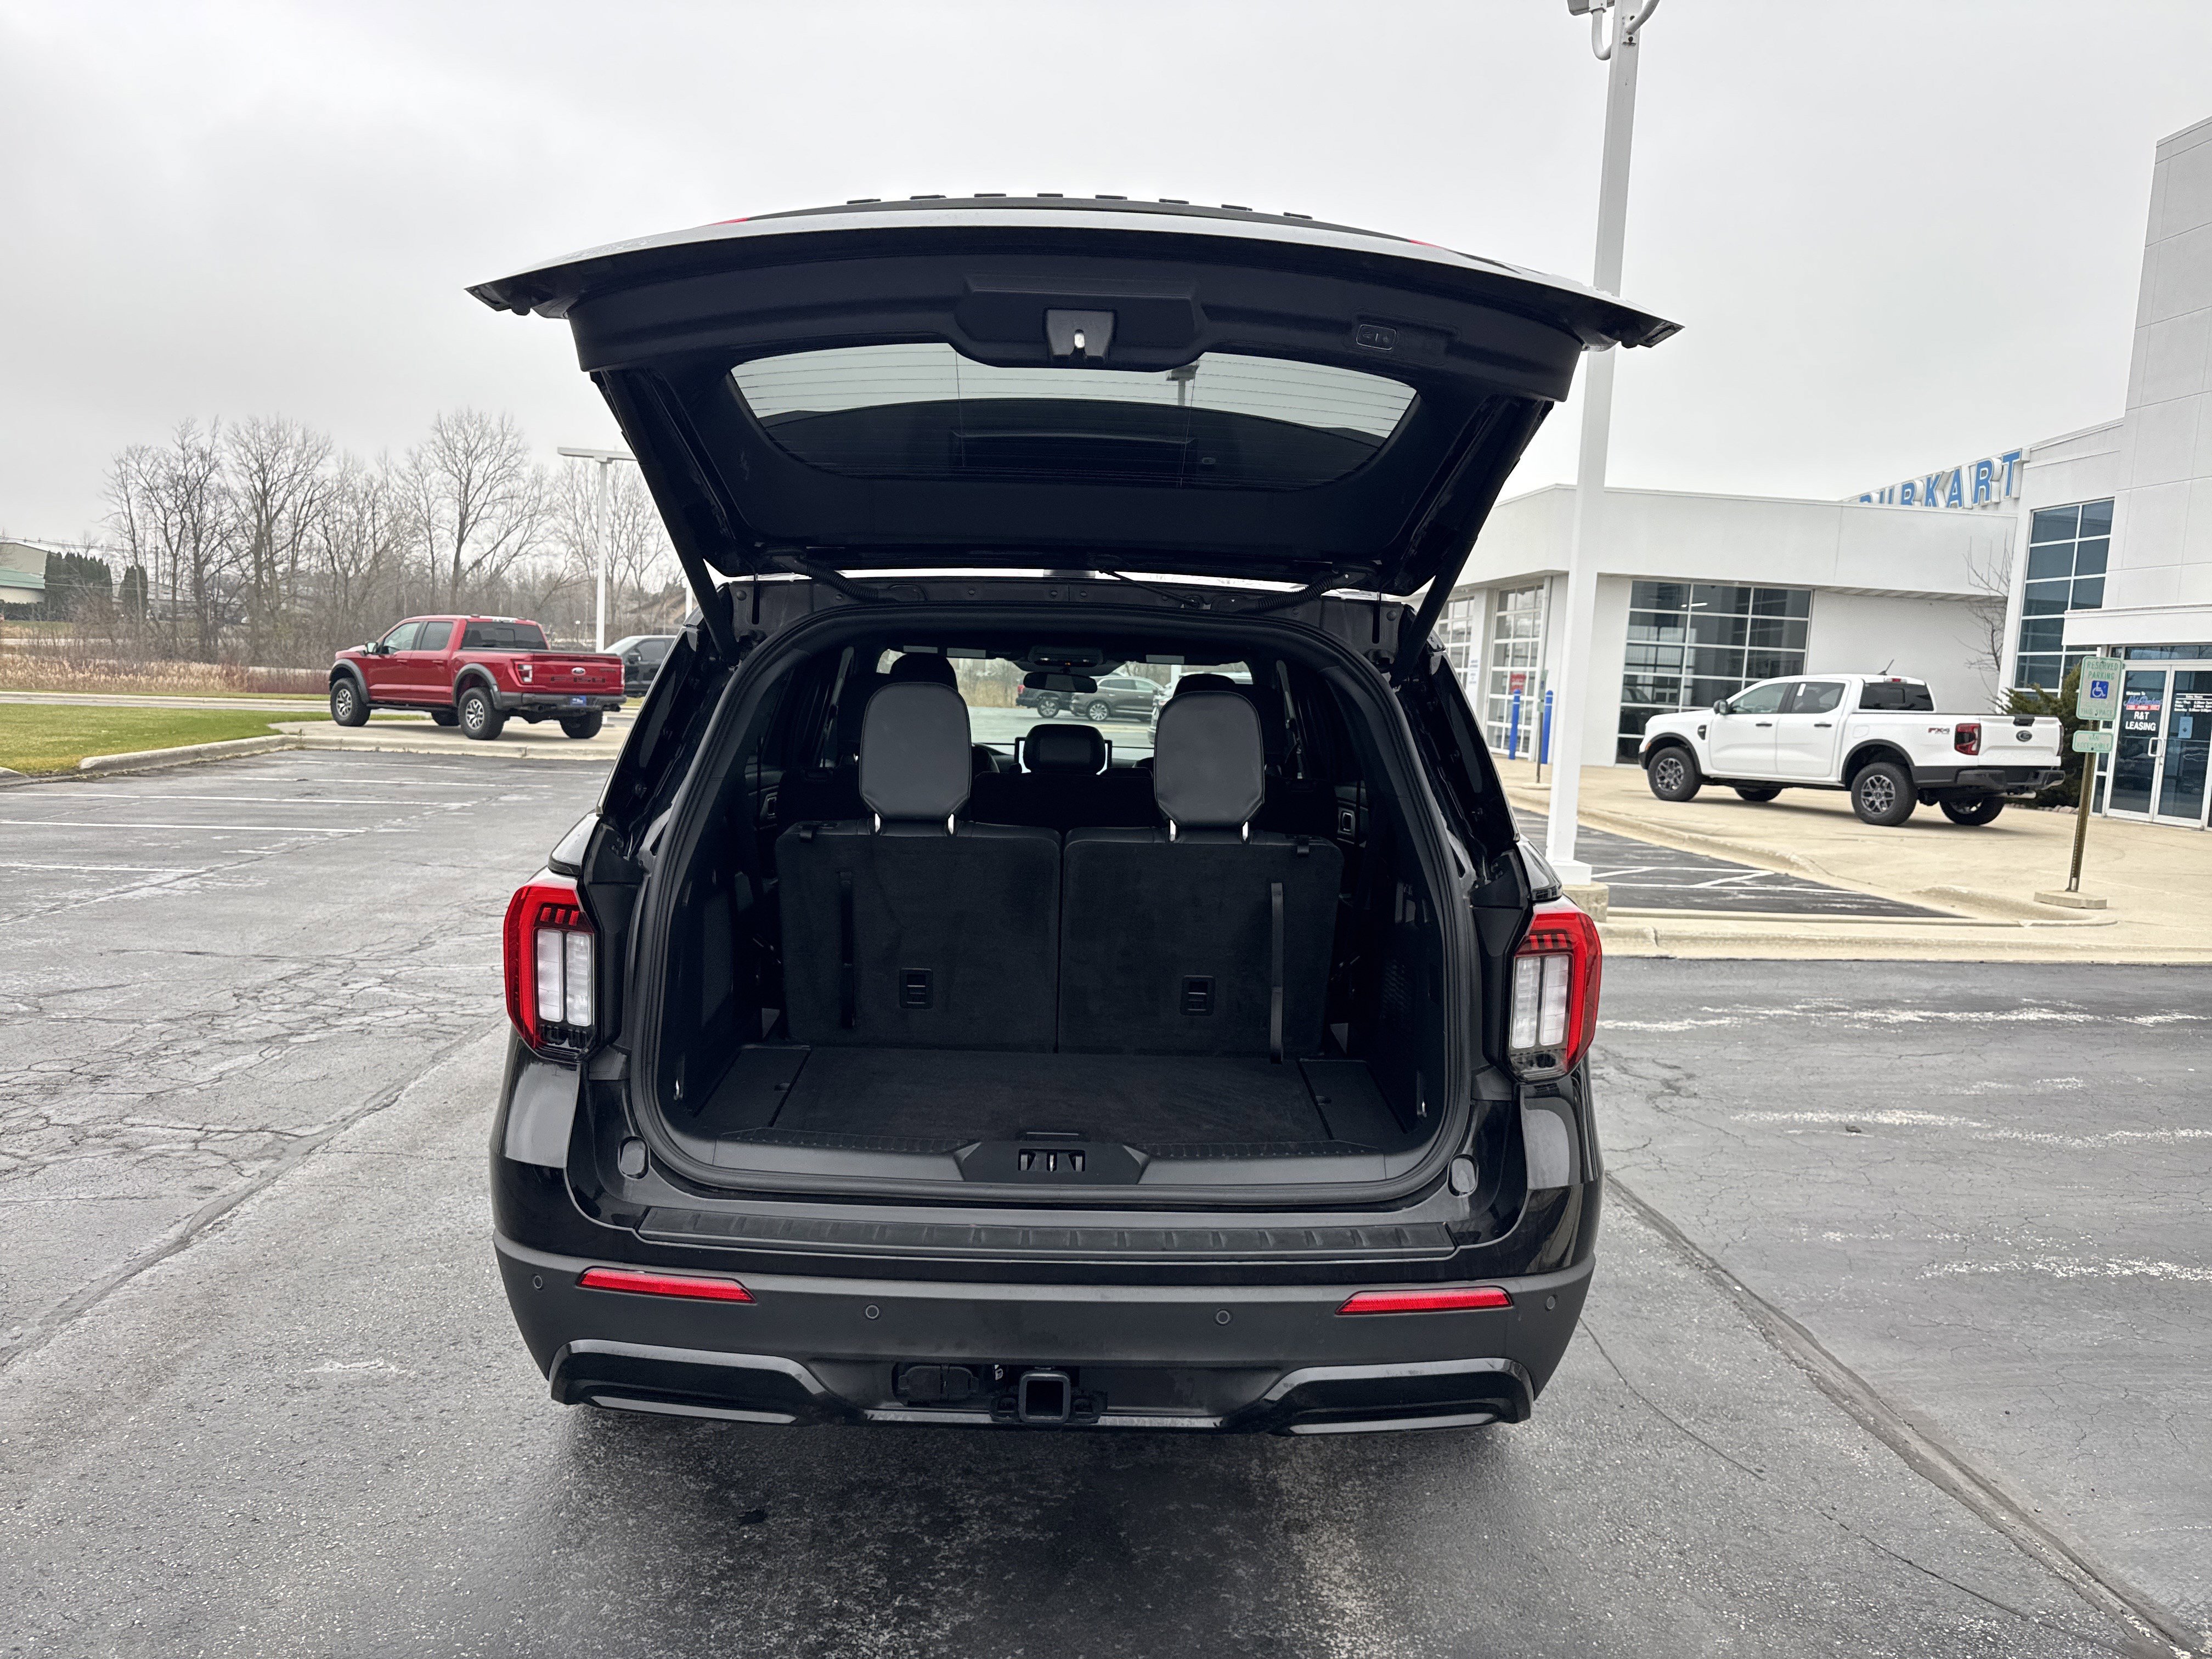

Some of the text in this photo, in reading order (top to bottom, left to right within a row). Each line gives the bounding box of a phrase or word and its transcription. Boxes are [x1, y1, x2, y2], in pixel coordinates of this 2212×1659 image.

[2086, 661, 2118, 670] RESERVED
[2087, 670, 2115, 680] PARKING
[2134, 710, 2150, 720] R&T
[2125, 720, 2157, 731] LEASING
